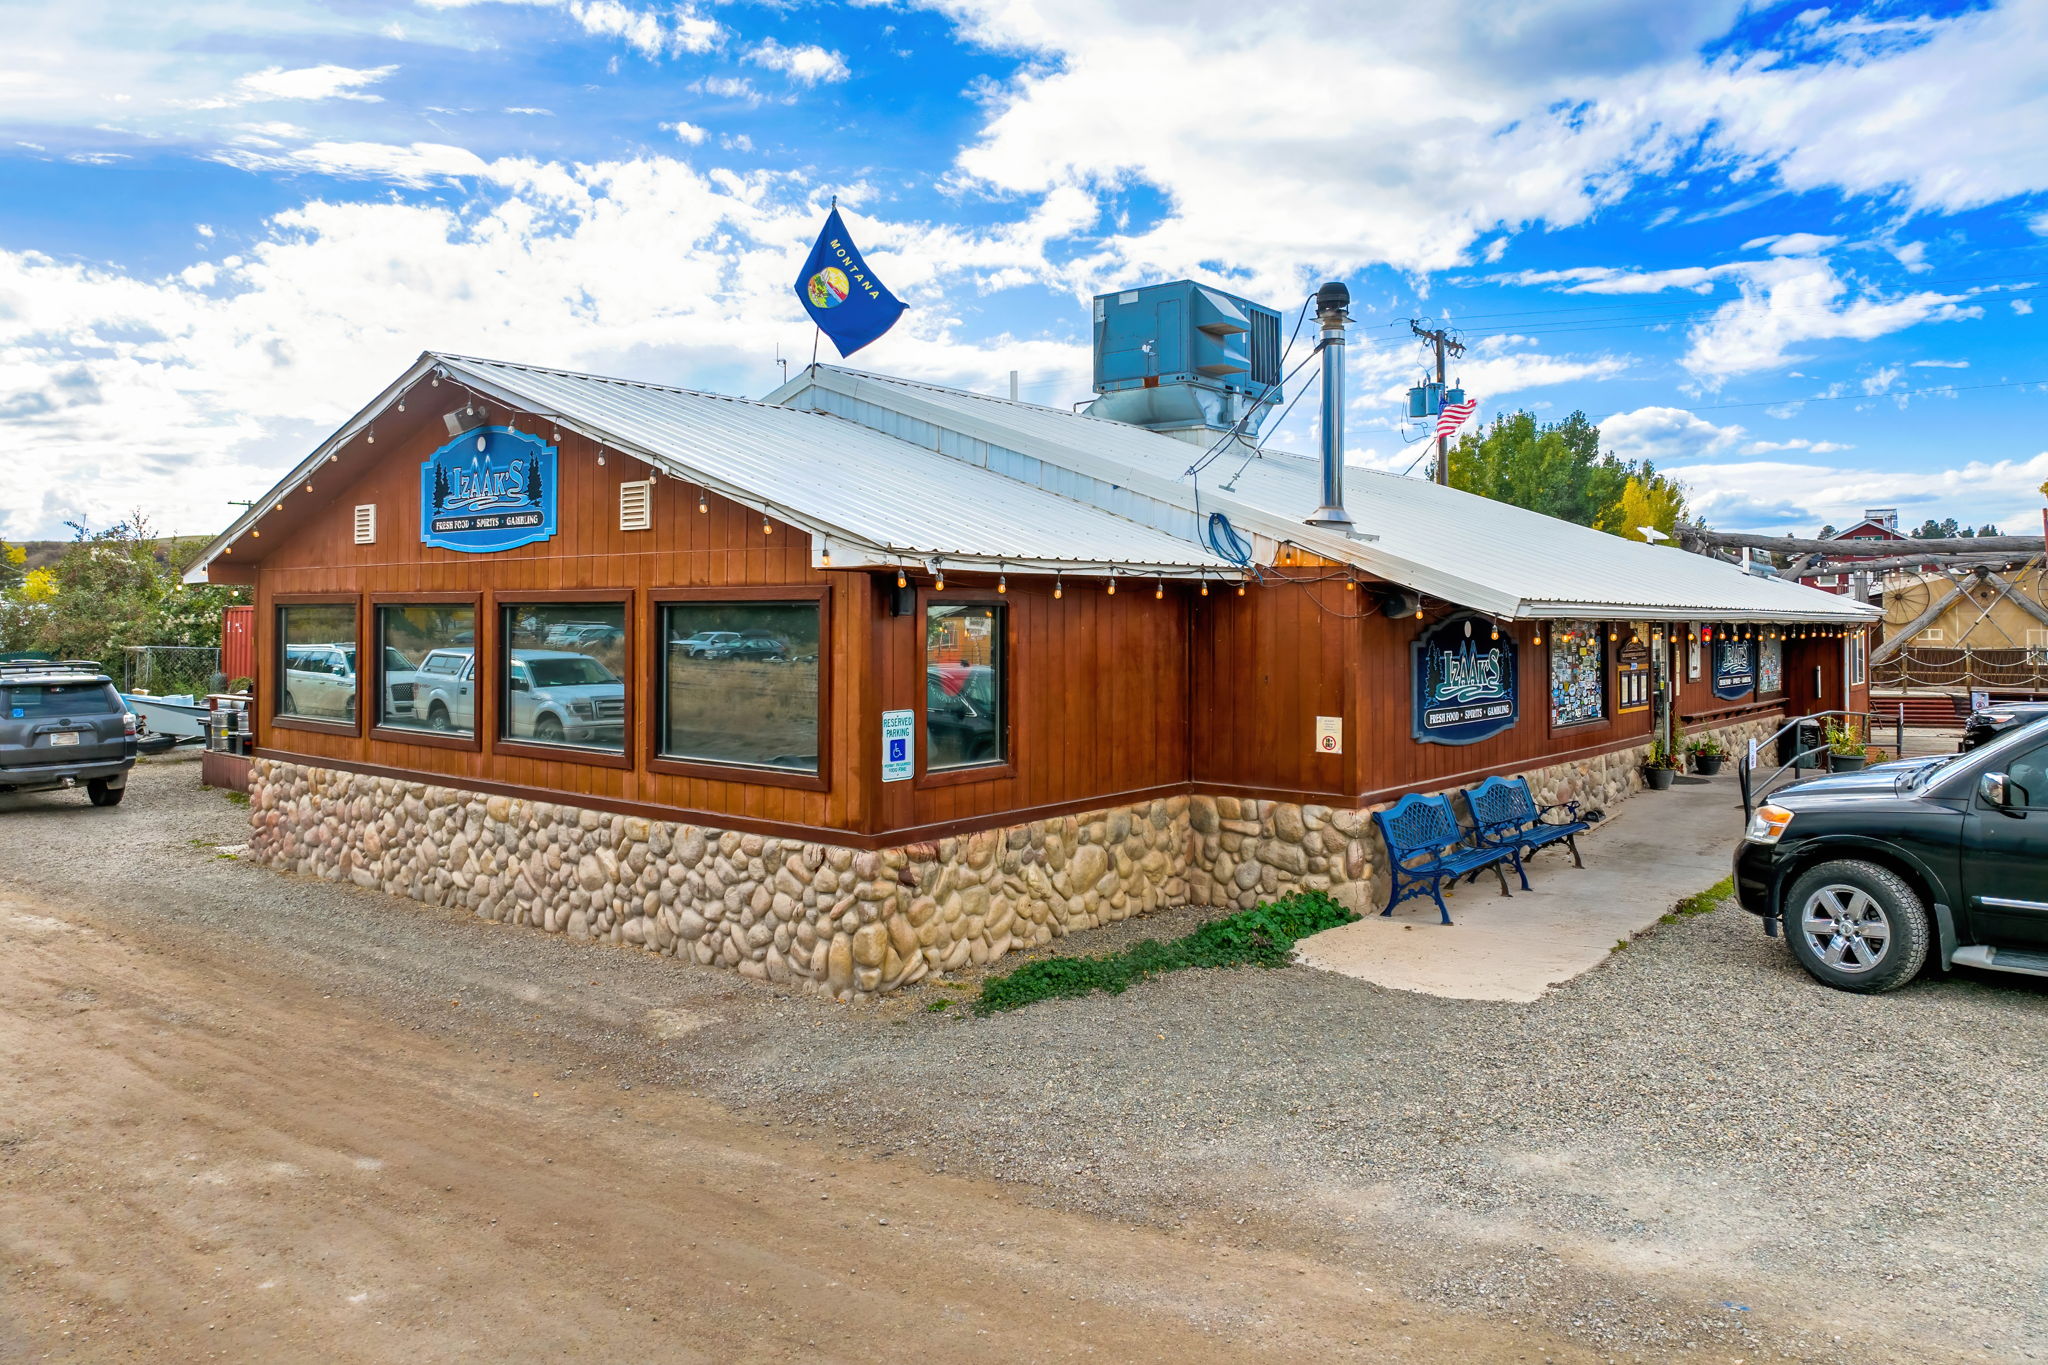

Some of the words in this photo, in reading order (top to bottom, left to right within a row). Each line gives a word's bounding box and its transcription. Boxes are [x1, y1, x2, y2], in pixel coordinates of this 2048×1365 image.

[831, 239, 879, 299] MONTANA
[436, 520, 453, 530] FRESH
[454, 519, 469, 529] FOOD
[476, 517, 499, 528] SPIRITS
[506, 515, 538, 525] GAMBLING
[1429, 713, 1446, 724] FRESH
[1446, 711, 1459, 722] FOOD
[1464, 708, 1483, 719] SPIRITS
[1487, 704, 1509, 716] GAMBLING
[883, 717, 912, 728] RESERVED
[886, 728, 910, 738] PARKING
